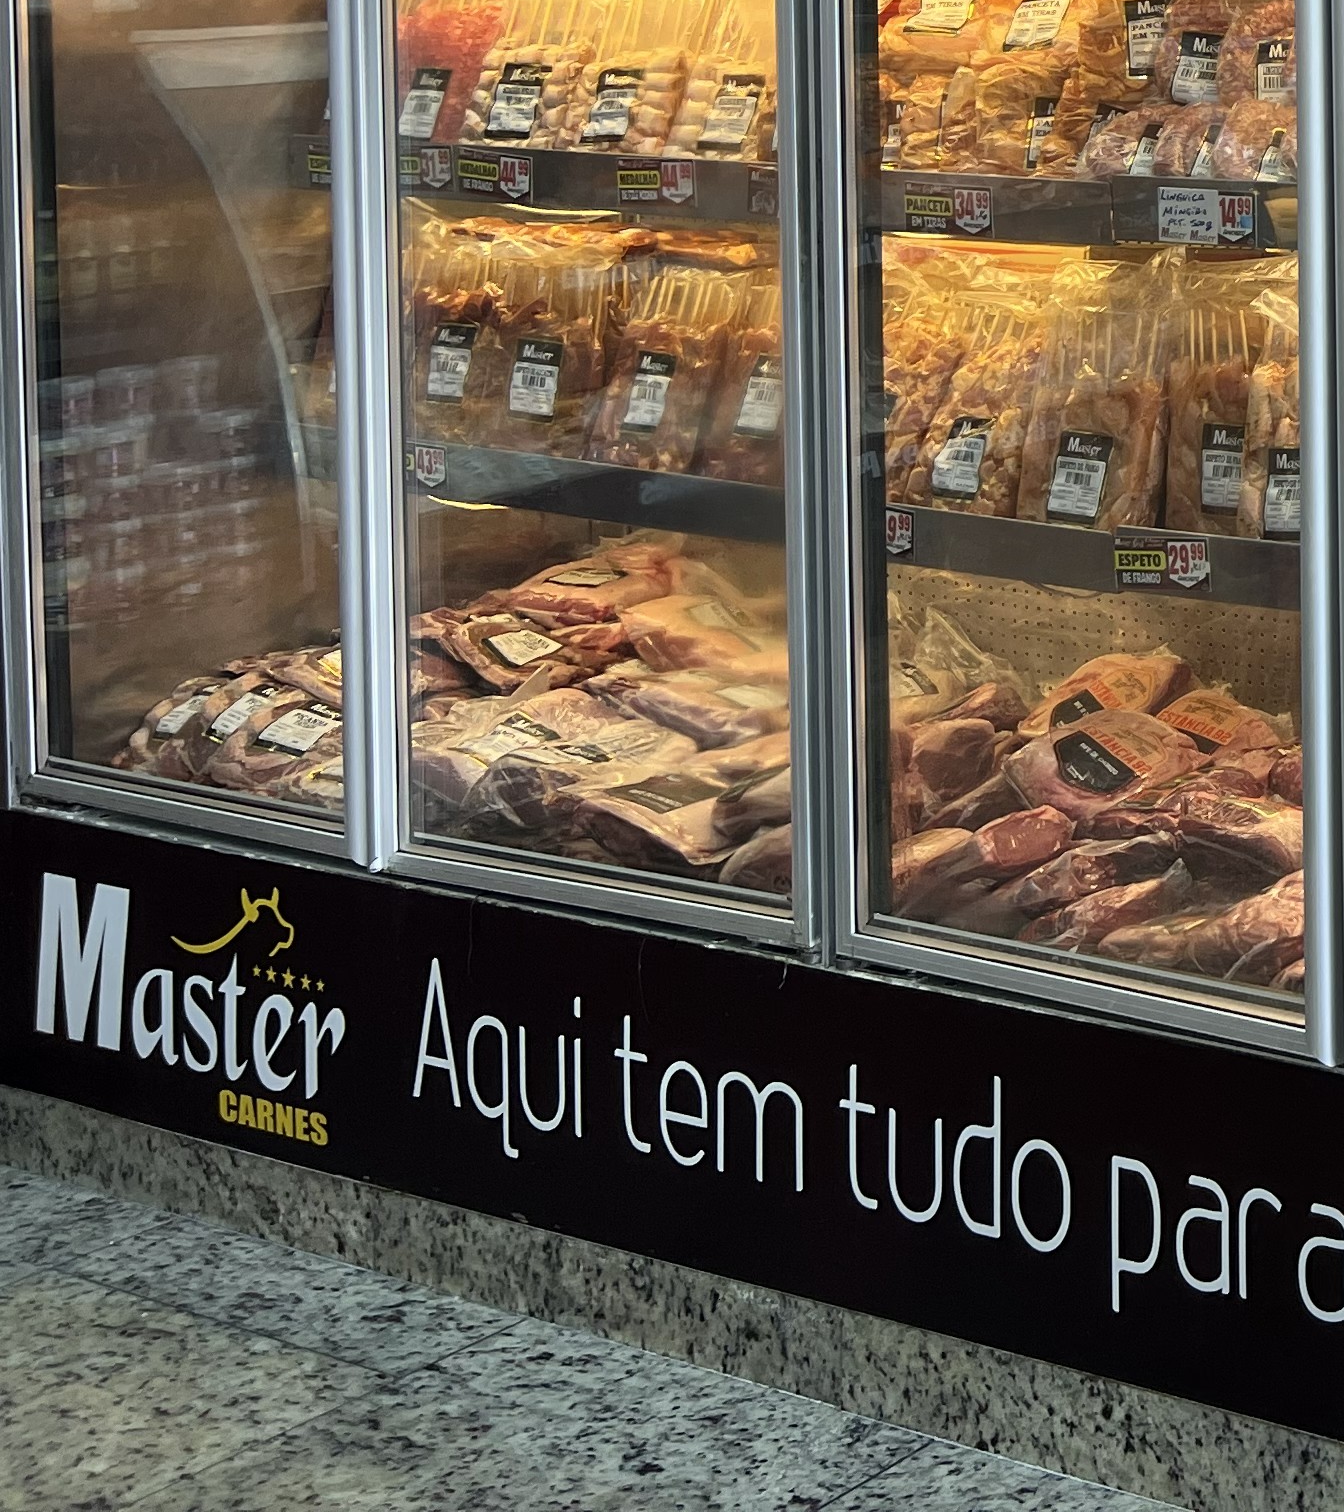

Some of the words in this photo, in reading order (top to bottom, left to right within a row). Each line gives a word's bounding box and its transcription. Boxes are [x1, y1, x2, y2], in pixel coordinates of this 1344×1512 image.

[907, 196, 951, 213] PANCETA
[911, 217, 923, 227] EM
[926, 217, 947, 228] TIRAS
[1118, 553, 1162, 567] ESPETO
[1122, 572, 1132, 583] DE
[1134, 573, 1161, 584] FRANGO
[35, 872, 346, 1101] Master
[412, 956, 585, 1159] Aqui
[614, 1014, 804, 1193] tem
[838, 1063, 1072, 1252] tudo
[218, 1087, 328, 1147] CARNES
